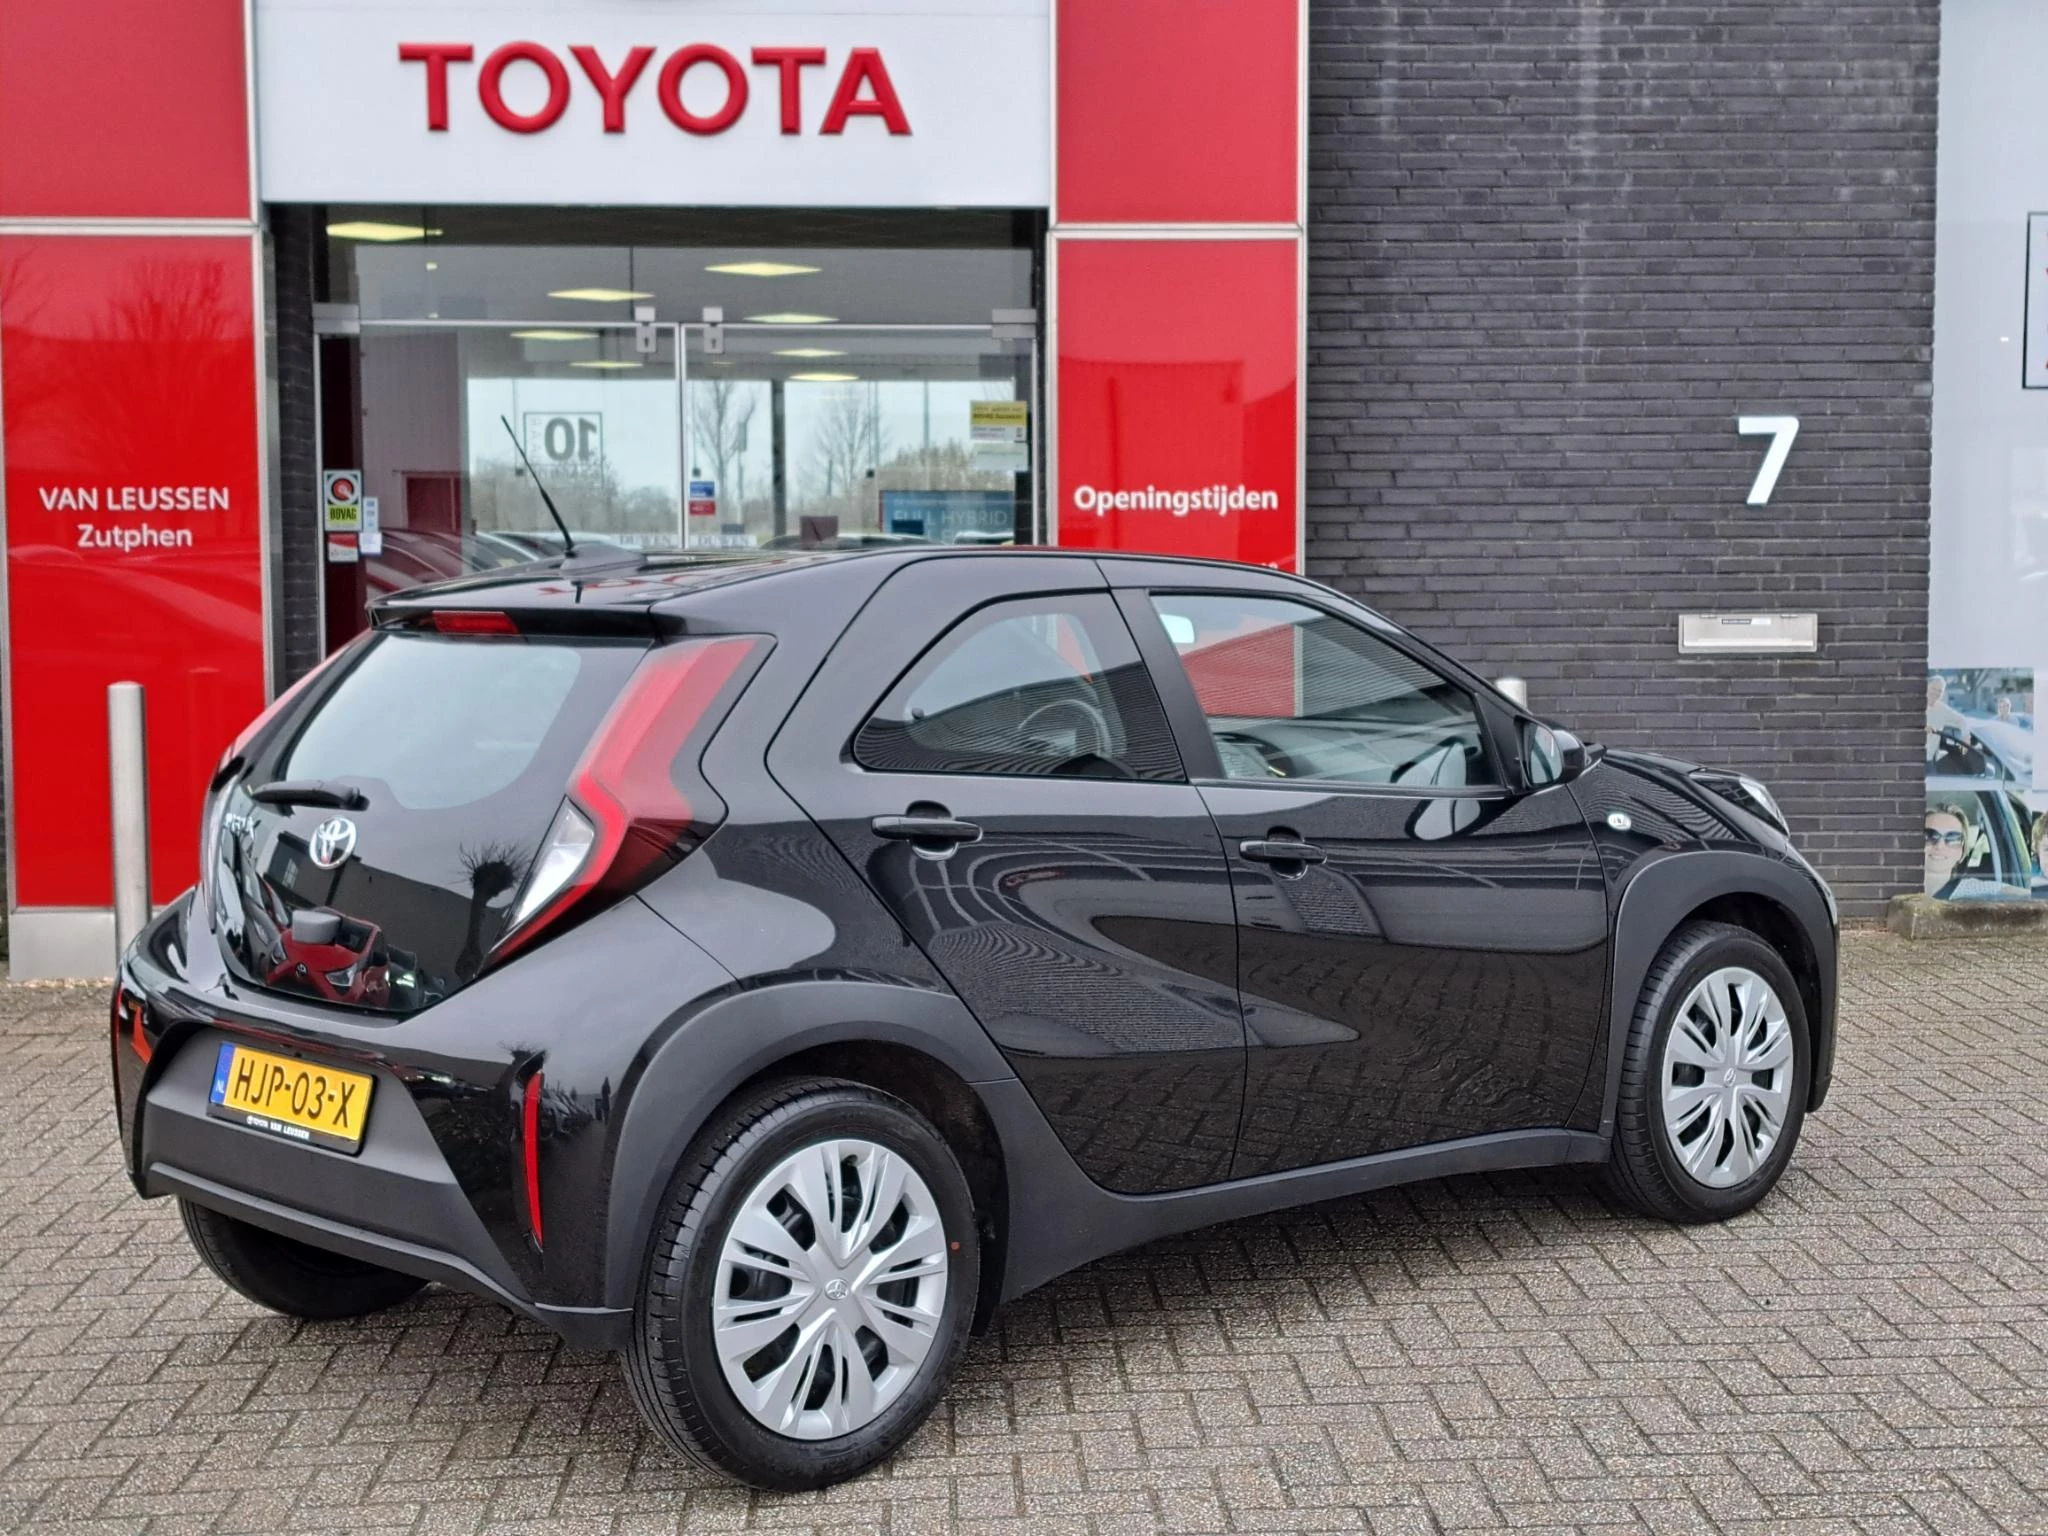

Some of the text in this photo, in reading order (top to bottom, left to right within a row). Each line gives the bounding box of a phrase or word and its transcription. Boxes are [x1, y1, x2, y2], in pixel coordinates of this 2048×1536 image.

[397, 41, 912, 136] TOYOTA
[1737, 415, 1801, 508] 7
[39, 487, 230, 511] VAN LEUSSEN
[330, 507, 357, 521] BOVAG
[1073, 484, 1279, 516] Openingstijden
[942, 510, 1008, 526] HYBRID
[77, 522, 193, 553] Zutphen
[234, 1057, 356, 1128] HJP-03-X
[283, 1125, 310, 1140] LEUSSEN
